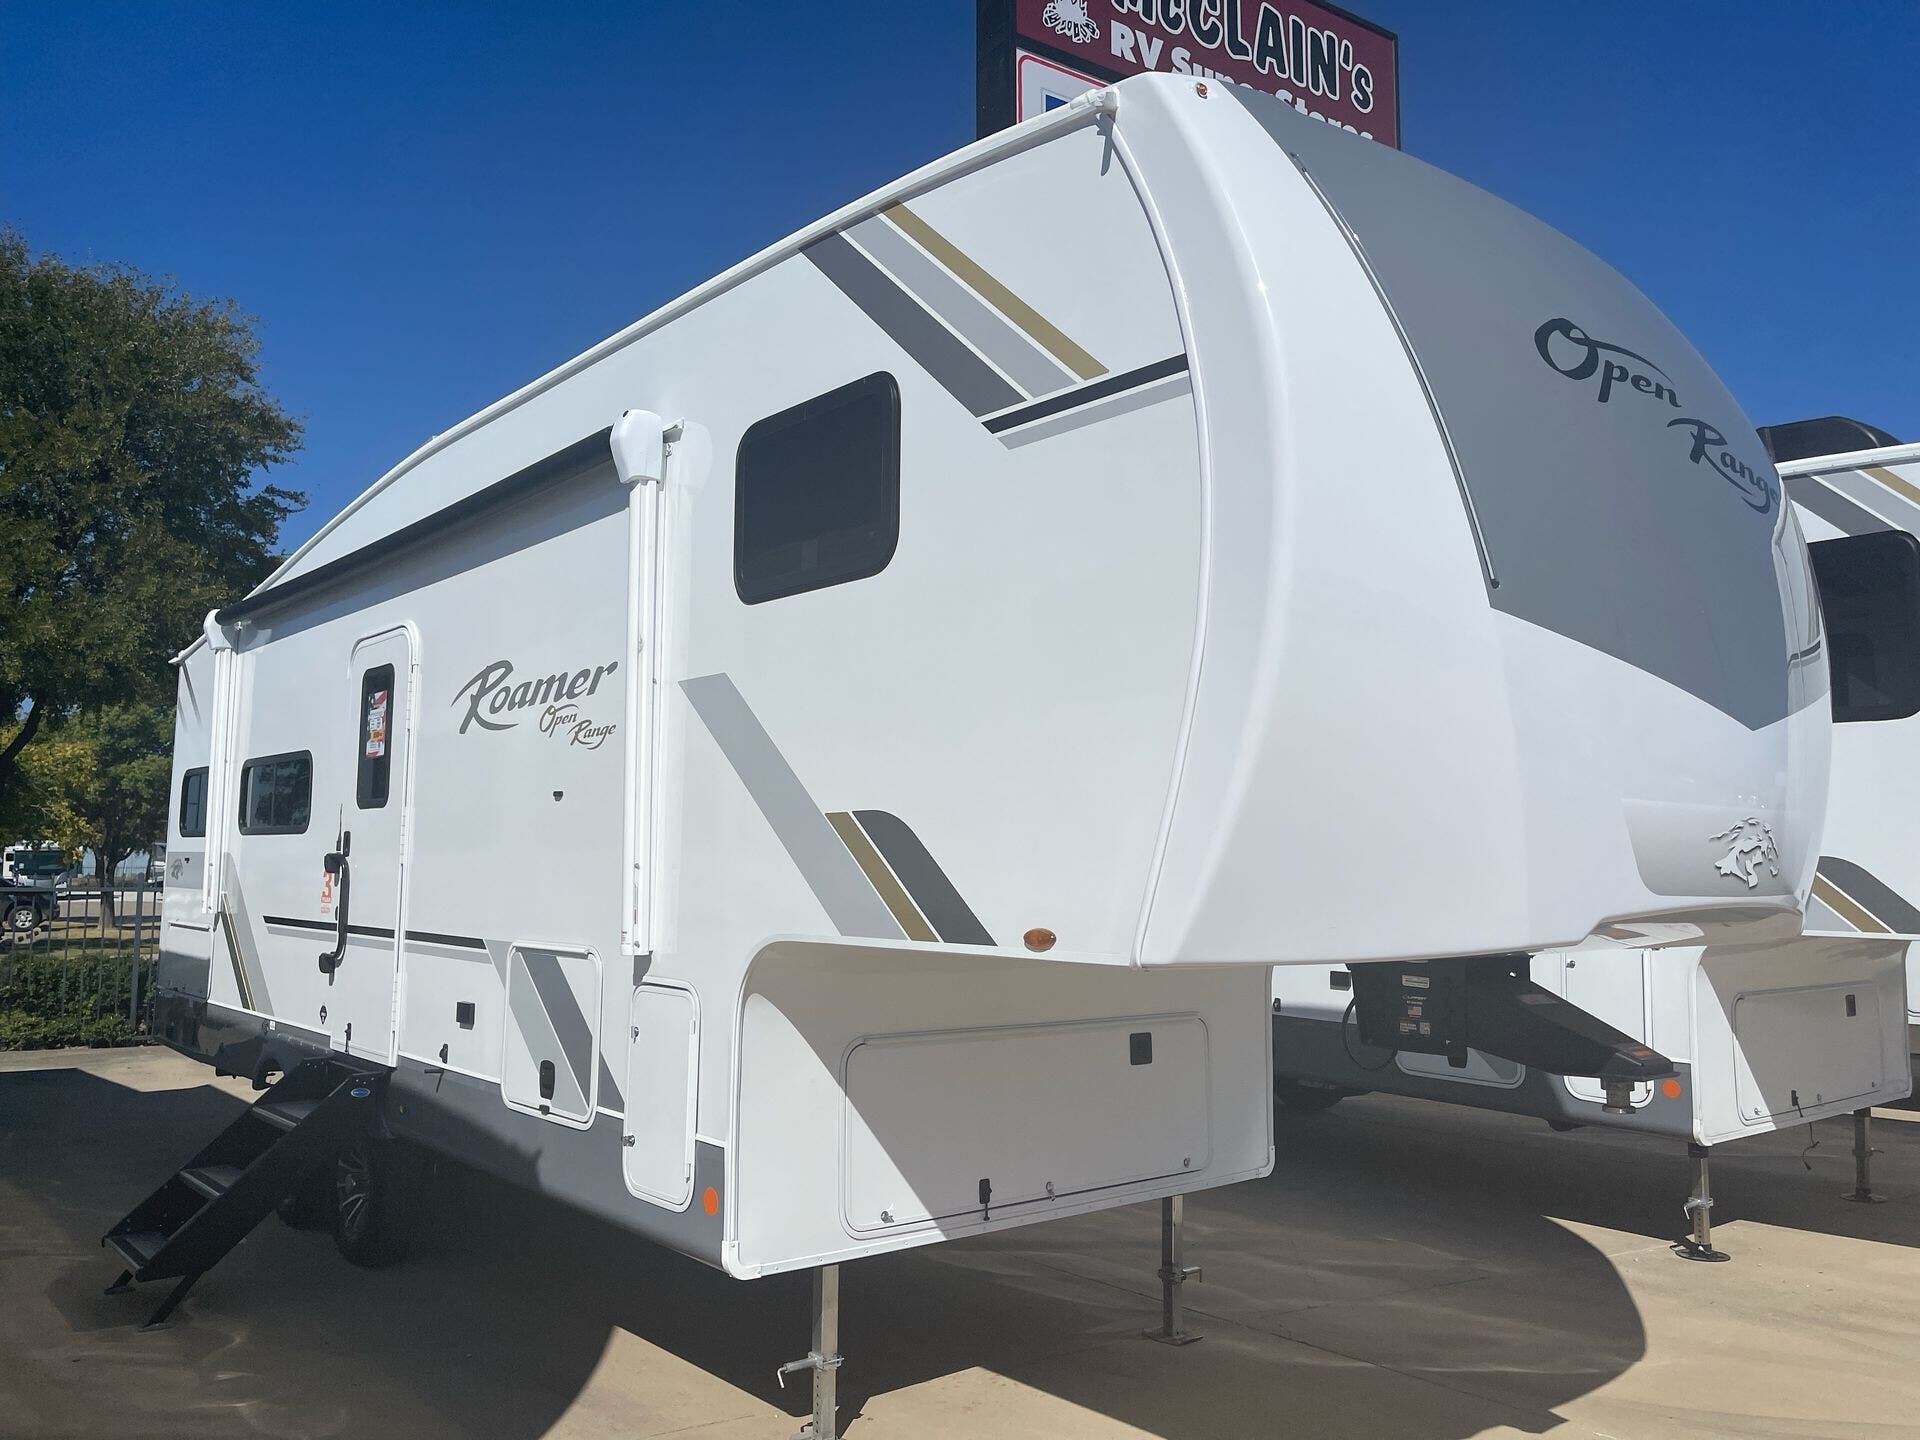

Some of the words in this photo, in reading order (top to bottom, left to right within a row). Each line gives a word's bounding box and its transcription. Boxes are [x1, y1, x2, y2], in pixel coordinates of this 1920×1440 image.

[1110, 19, 1164, 71] RV
[1534, 317, 1682, 408] Open
[1667, 417, 1779, 515] Range
[450, 659, 619, 735] Roamer
[539, 703, 580, 738] Open
[567, 719, 617, 751] Range
